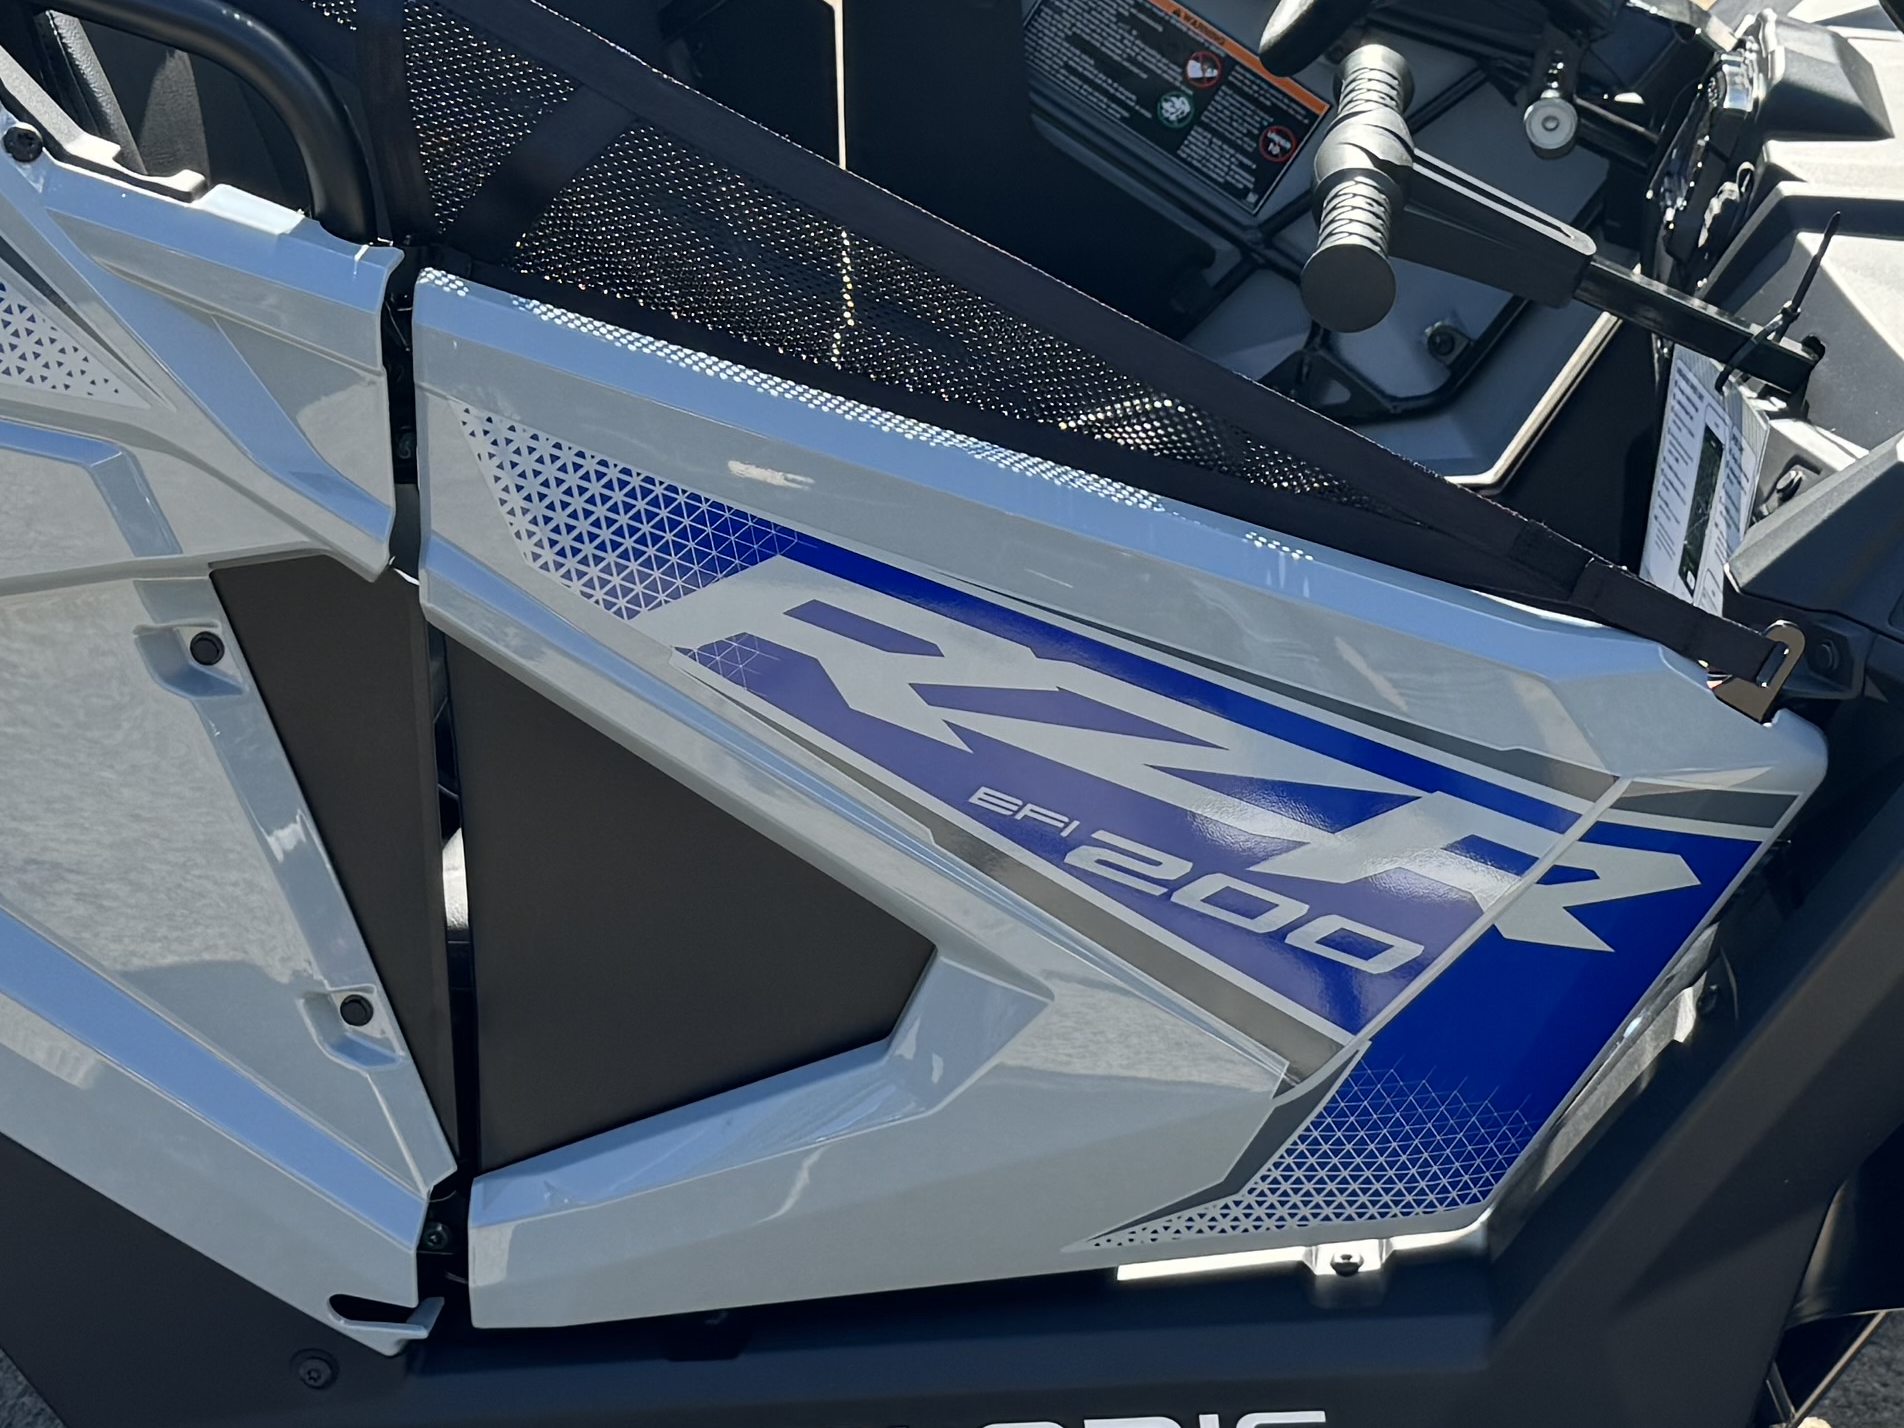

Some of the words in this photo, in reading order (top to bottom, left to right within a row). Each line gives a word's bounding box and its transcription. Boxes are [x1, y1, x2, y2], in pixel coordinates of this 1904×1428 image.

[631, 555, 1700, 952] RZR
[968, 785, 1081, 841] EFI
[1064, 830, 1425, 974] 200
